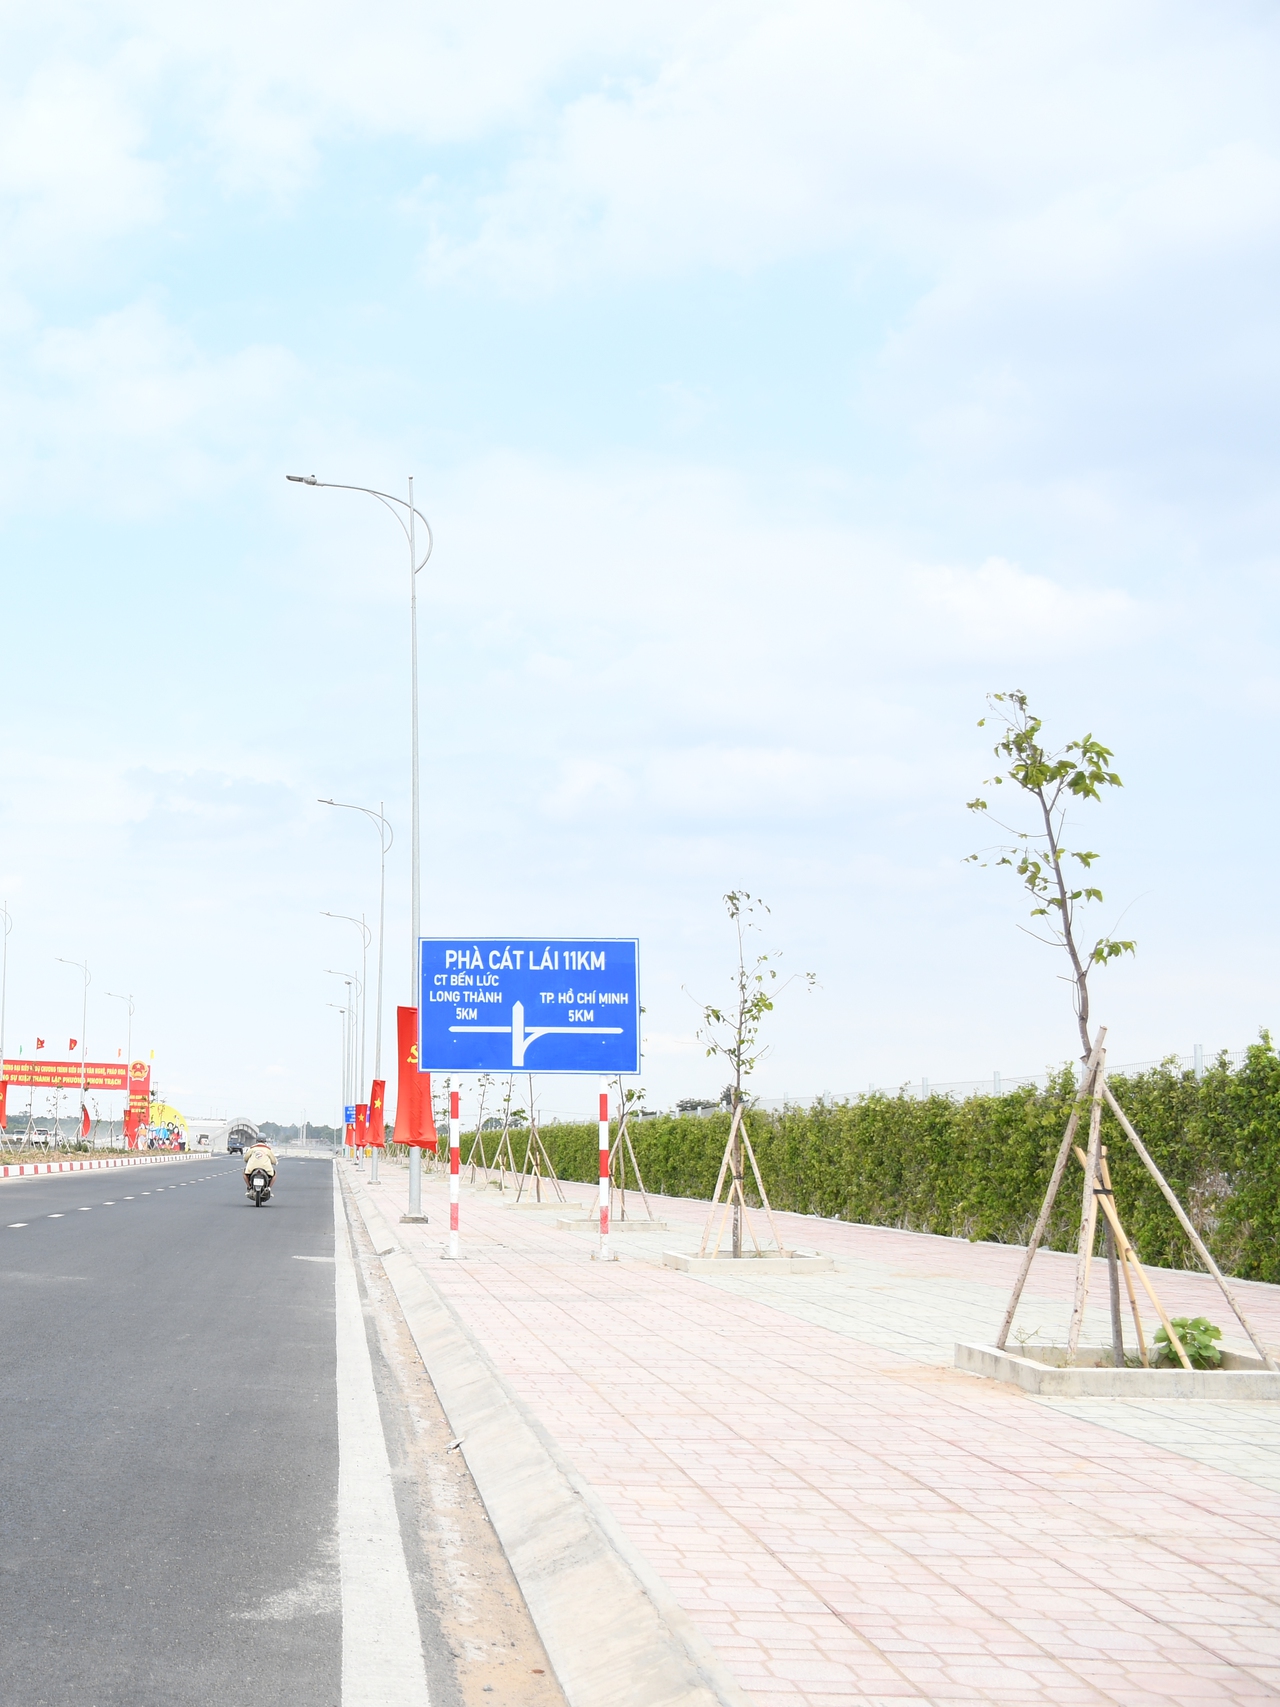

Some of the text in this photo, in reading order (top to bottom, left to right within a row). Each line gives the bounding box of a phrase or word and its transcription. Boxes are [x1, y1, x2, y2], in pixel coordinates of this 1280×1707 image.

[446, 946, 606, 971] PHÀ CÁT LÁI 11KM
[434, 971, 499, 986] CT BẾN LỨC
[429, 989, 502, 1003] LONG THÀNH
[540, 988, 628, 1004] TP. HỒ CHÍ MINH
[456, 1008, 477, 1020] 5KM
[568, 1010, 594, 1022] 5KM
[32, 1075, 50, 1083] THÀNH
